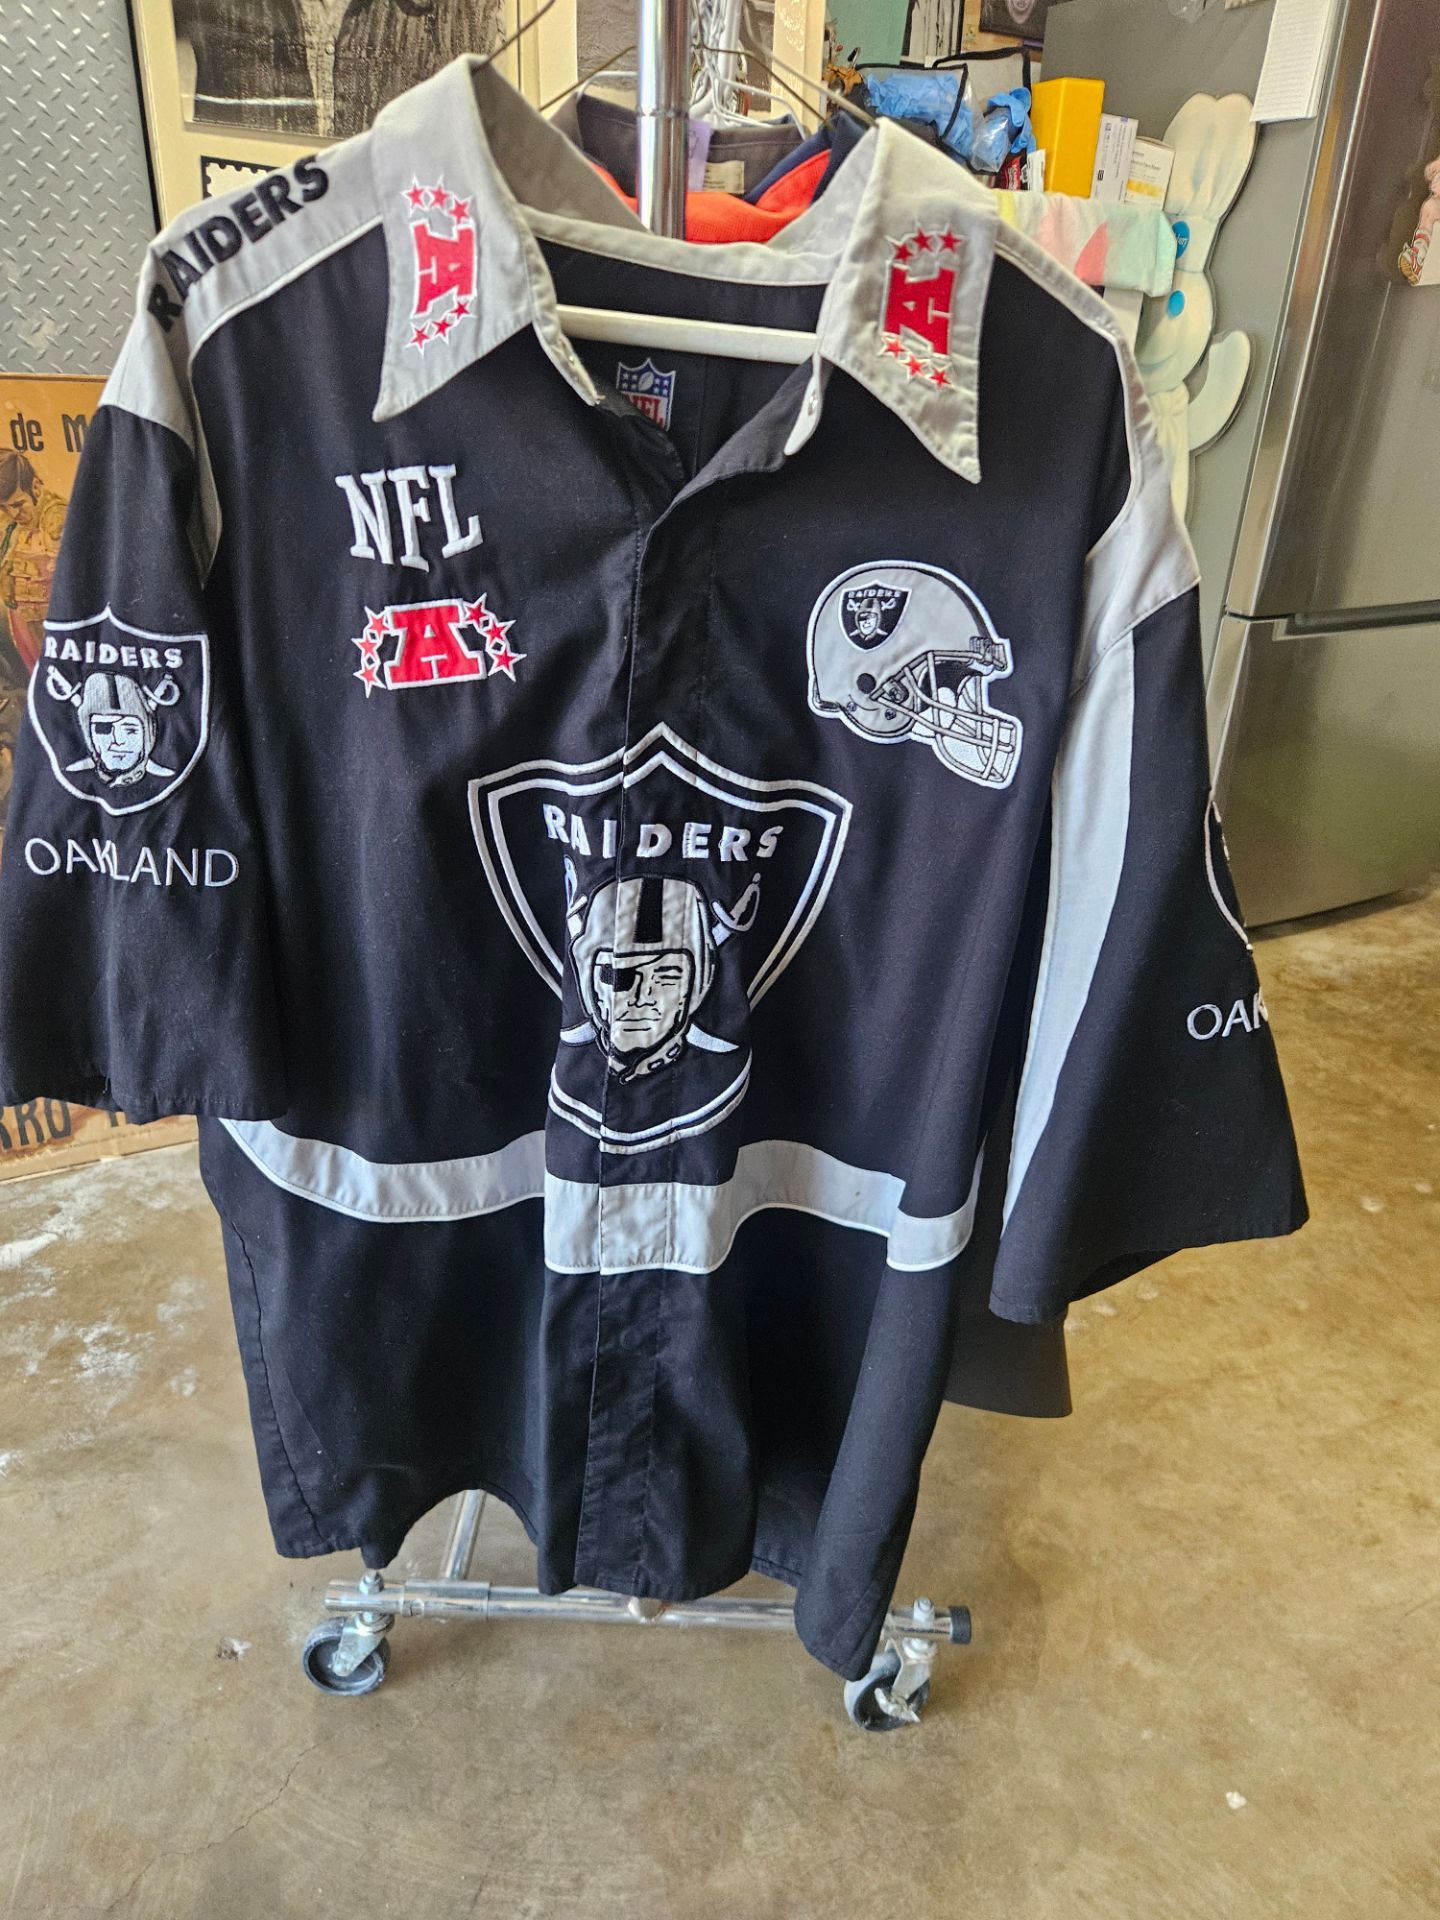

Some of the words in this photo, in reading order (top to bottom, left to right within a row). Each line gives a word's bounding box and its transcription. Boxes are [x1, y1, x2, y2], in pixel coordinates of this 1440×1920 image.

[147, 155, 329, 333] RAIDERS
[9, 412, 44, 452] de
[335, 464, 483, 572] NFL
[848, 589, 901, 598] RAIDERS
[45, 636, 184, 669] RAIDERS
[383, 598, 487, 690] A
[542, 803, 784, 862] RAIDERS
[25, 837, 239, 887] OAKLAND
